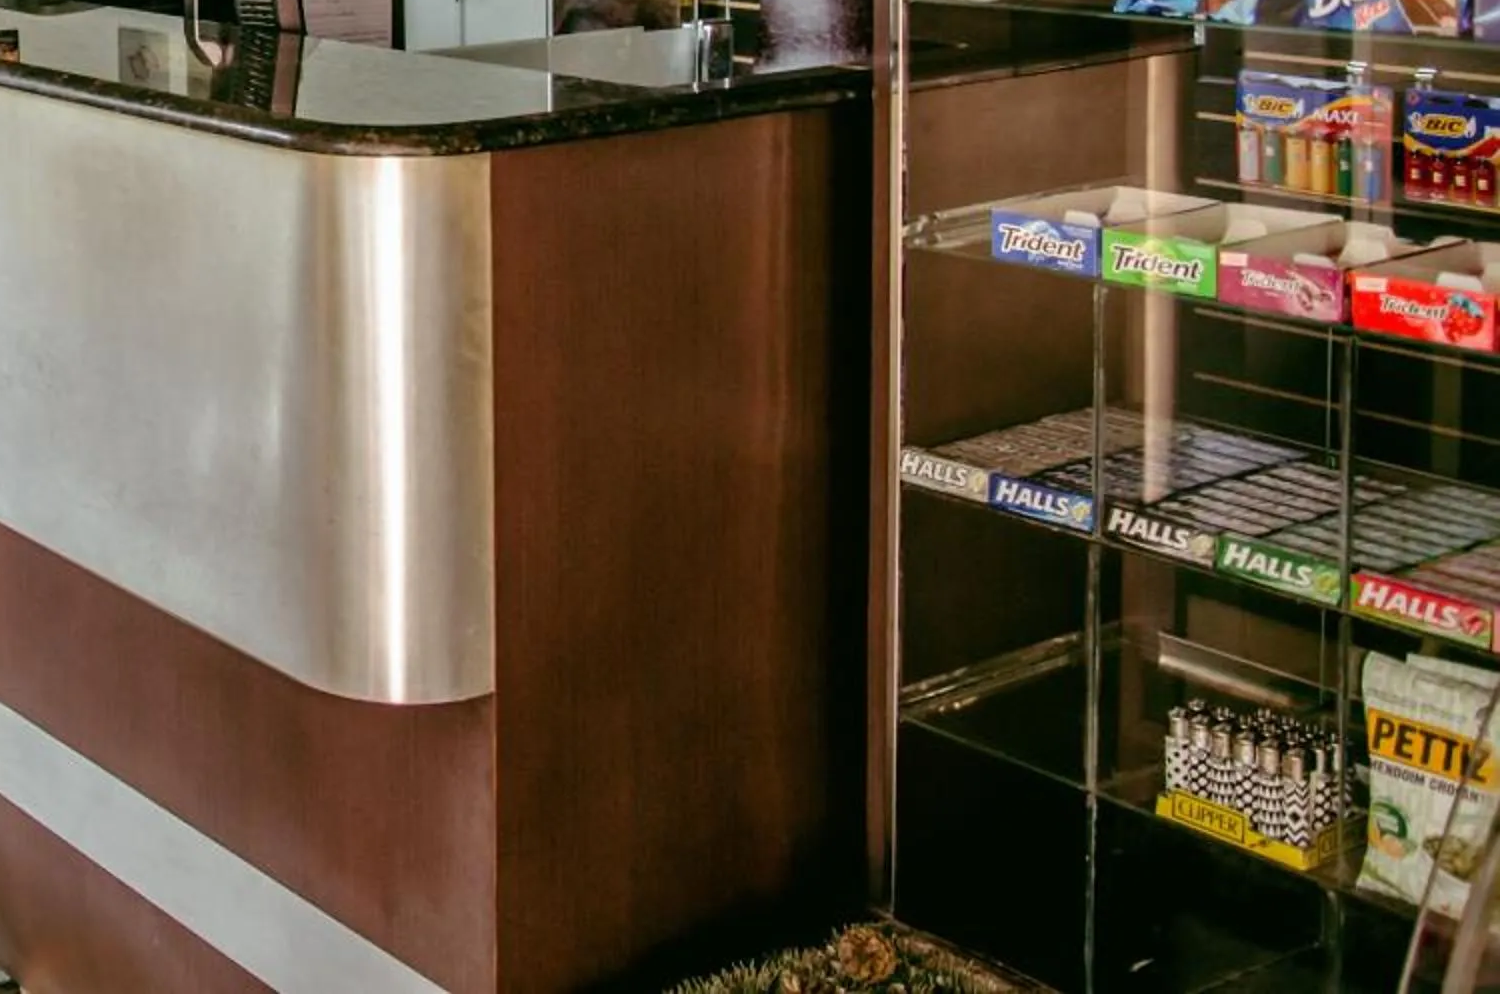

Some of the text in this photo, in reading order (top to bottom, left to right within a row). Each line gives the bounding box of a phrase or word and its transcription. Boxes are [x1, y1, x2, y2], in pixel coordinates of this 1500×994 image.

[999, 223, 1085, 259] Trident
[1113, 244, 1202, 280] Trident
[1241, 269, 1300, 293] Trident
[1380, 294, 1449, 319] Trident
[901, 453, 967, 487] HALLS
[996, 480, 1070, 516] HALLS
[1108, 508, 1189, 550] HALLS
[1223, 542, 1313, 587] HALLS
[1358, 581, 1460, 627] HALLS
[1177, 799, 1238, 835] CLIPPER
